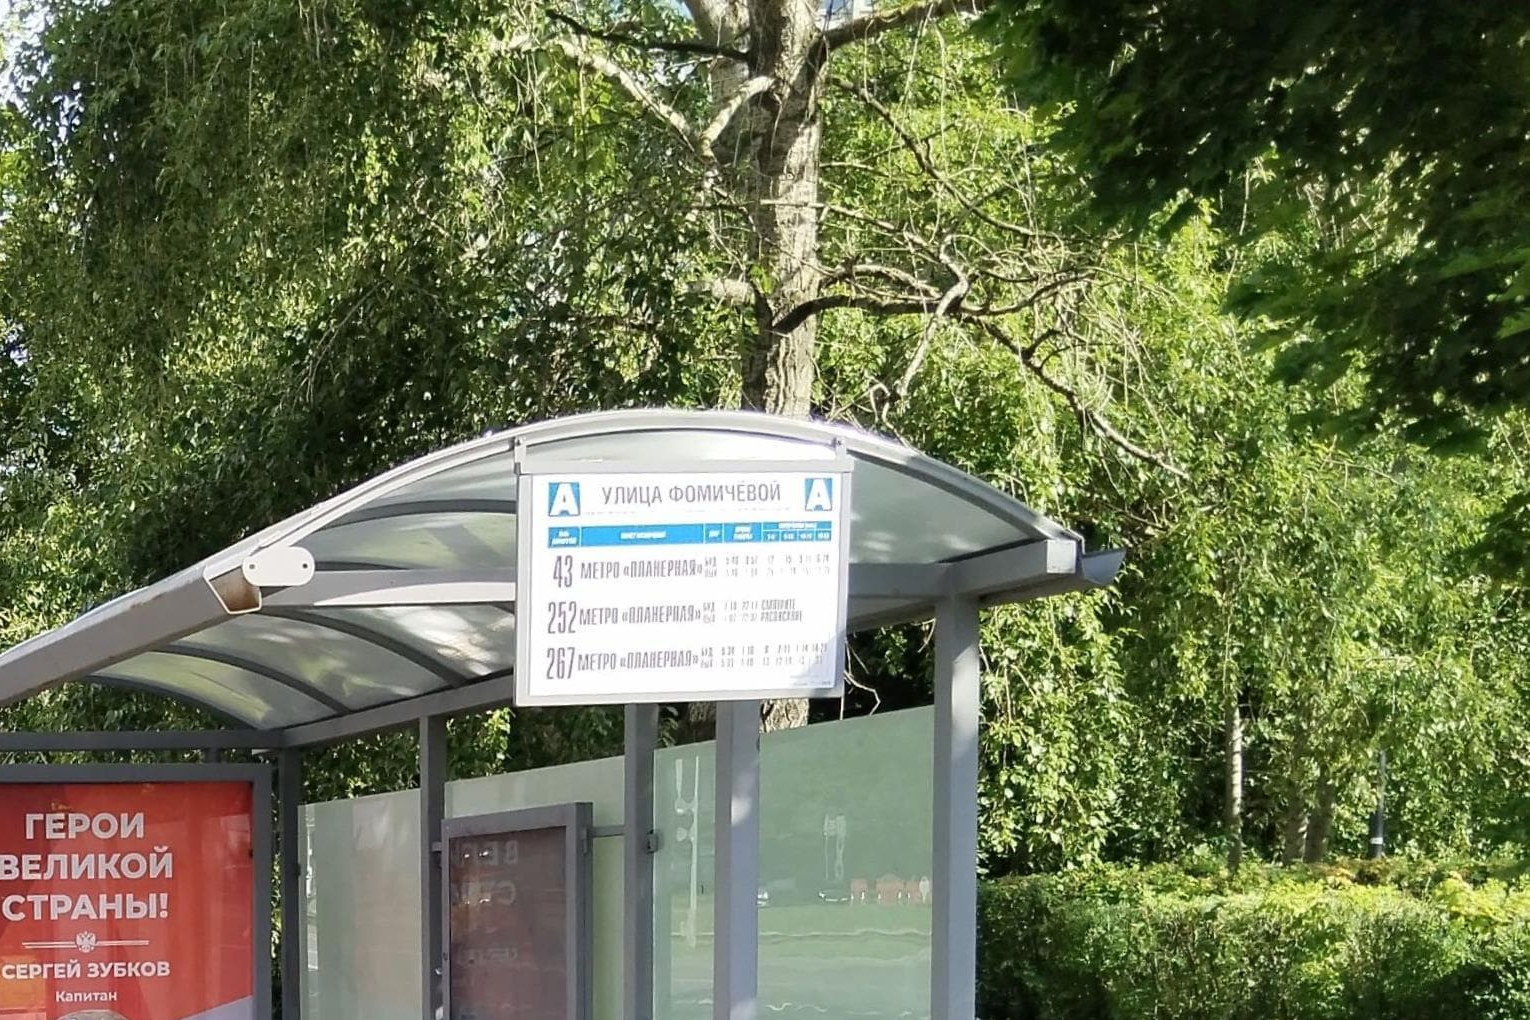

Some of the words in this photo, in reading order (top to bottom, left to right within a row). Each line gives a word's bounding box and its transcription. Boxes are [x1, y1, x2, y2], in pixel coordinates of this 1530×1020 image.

[602, 486, 662, 507] УЛИЦА
[553, 555, 573, 588] 43
[580, 562, 619, 580] МЕТРО
[547, 601, 577, 634] 252
[579, 608, 618, 626] МЕТРО
[546, 647, 575, 680] 267
[577, 654, 616, 671] МЕТРО
[25, 813, 144, 839] ГЕРОИ
[2, 894, 168, 921] СТРАНЫ!
[1, 959, 81, 979] СЕРГЕЙ
[88, 962, 170, 978] ЗУБКОВ
[56, 991, 117, 1003] Капитан
